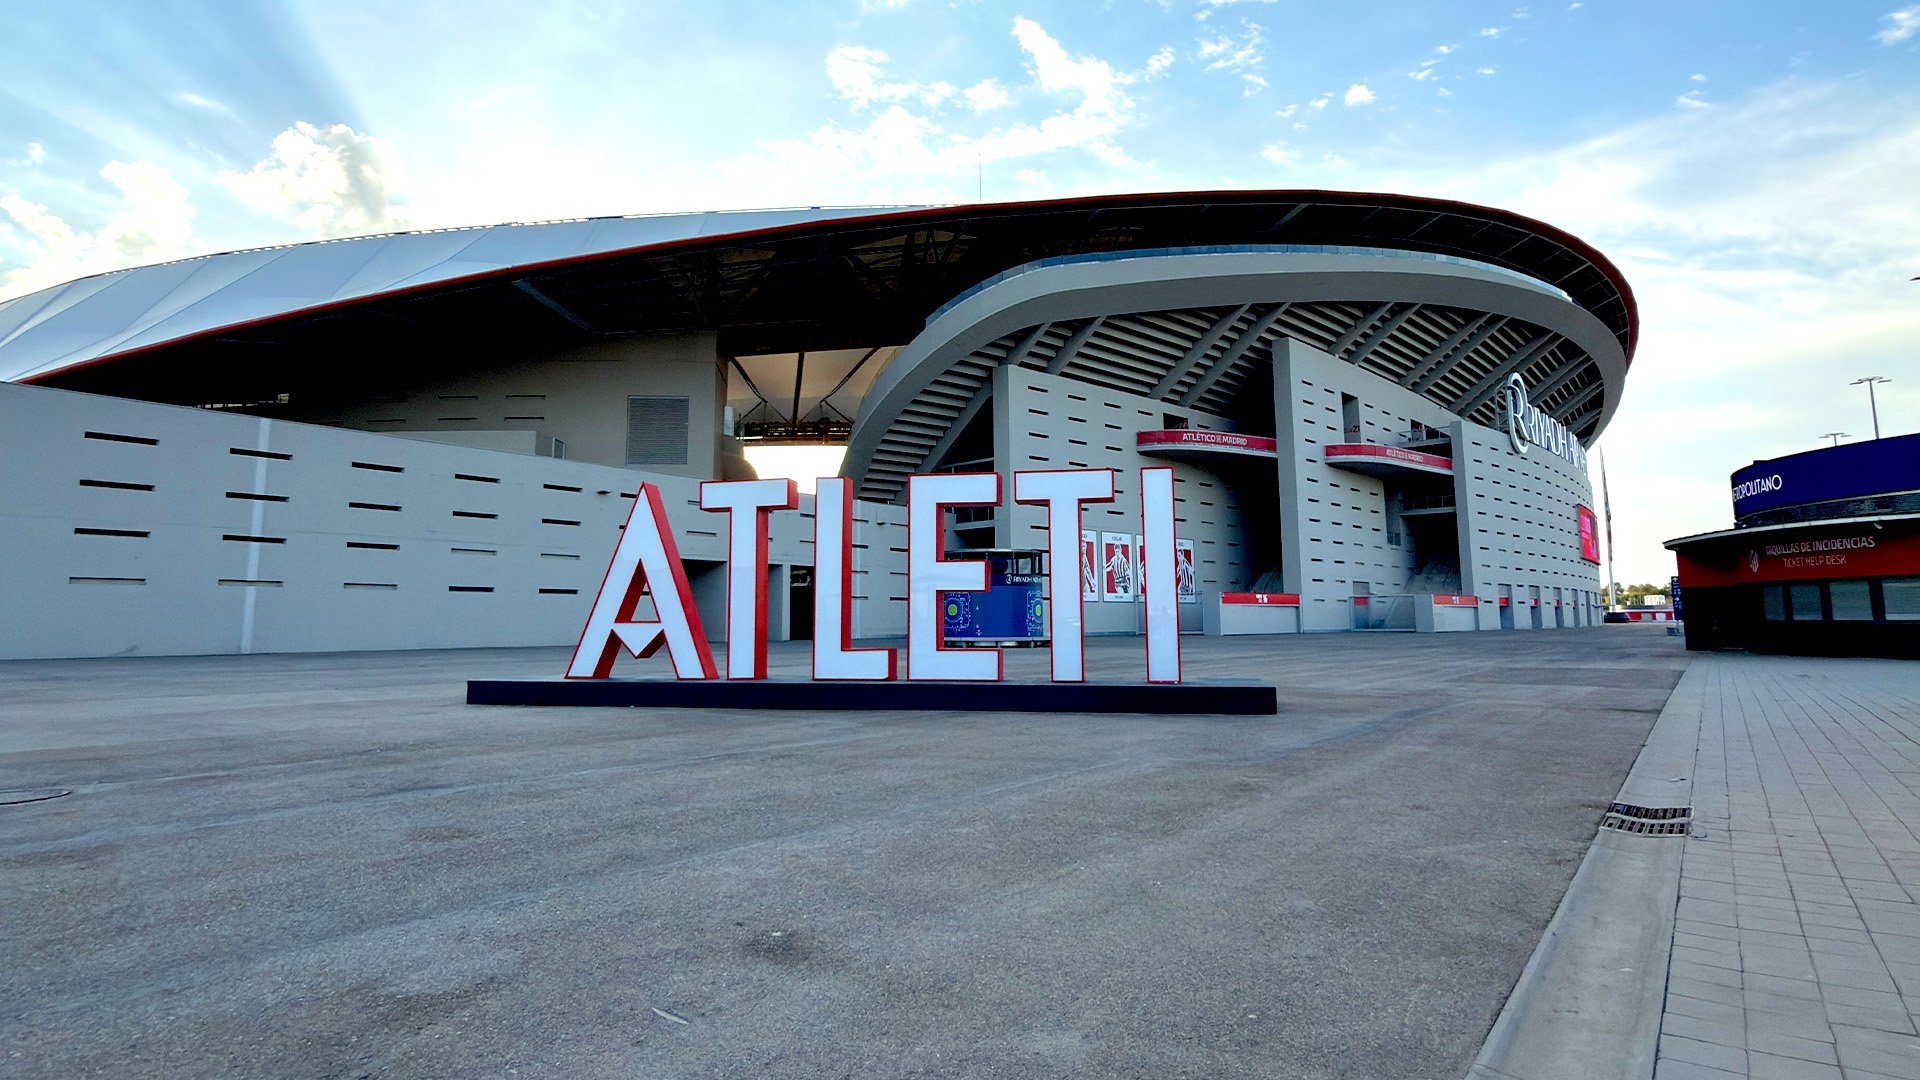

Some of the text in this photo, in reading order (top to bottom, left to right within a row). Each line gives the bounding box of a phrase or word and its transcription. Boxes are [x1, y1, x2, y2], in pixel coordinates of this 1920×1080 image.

[1182, 431, 1216, 443] ATLÉTICO
[1222, 436, 1248, 446] MADRID
[1527, 403, 1569, 462] RIYADH
[1765, 536, 1876, 556] TAQUILLAS DE INCIDENCIAS
[1783, 555, 1847, 568] TICKET HELP DESK
[565, 466, 1181, 685] ATLETI
